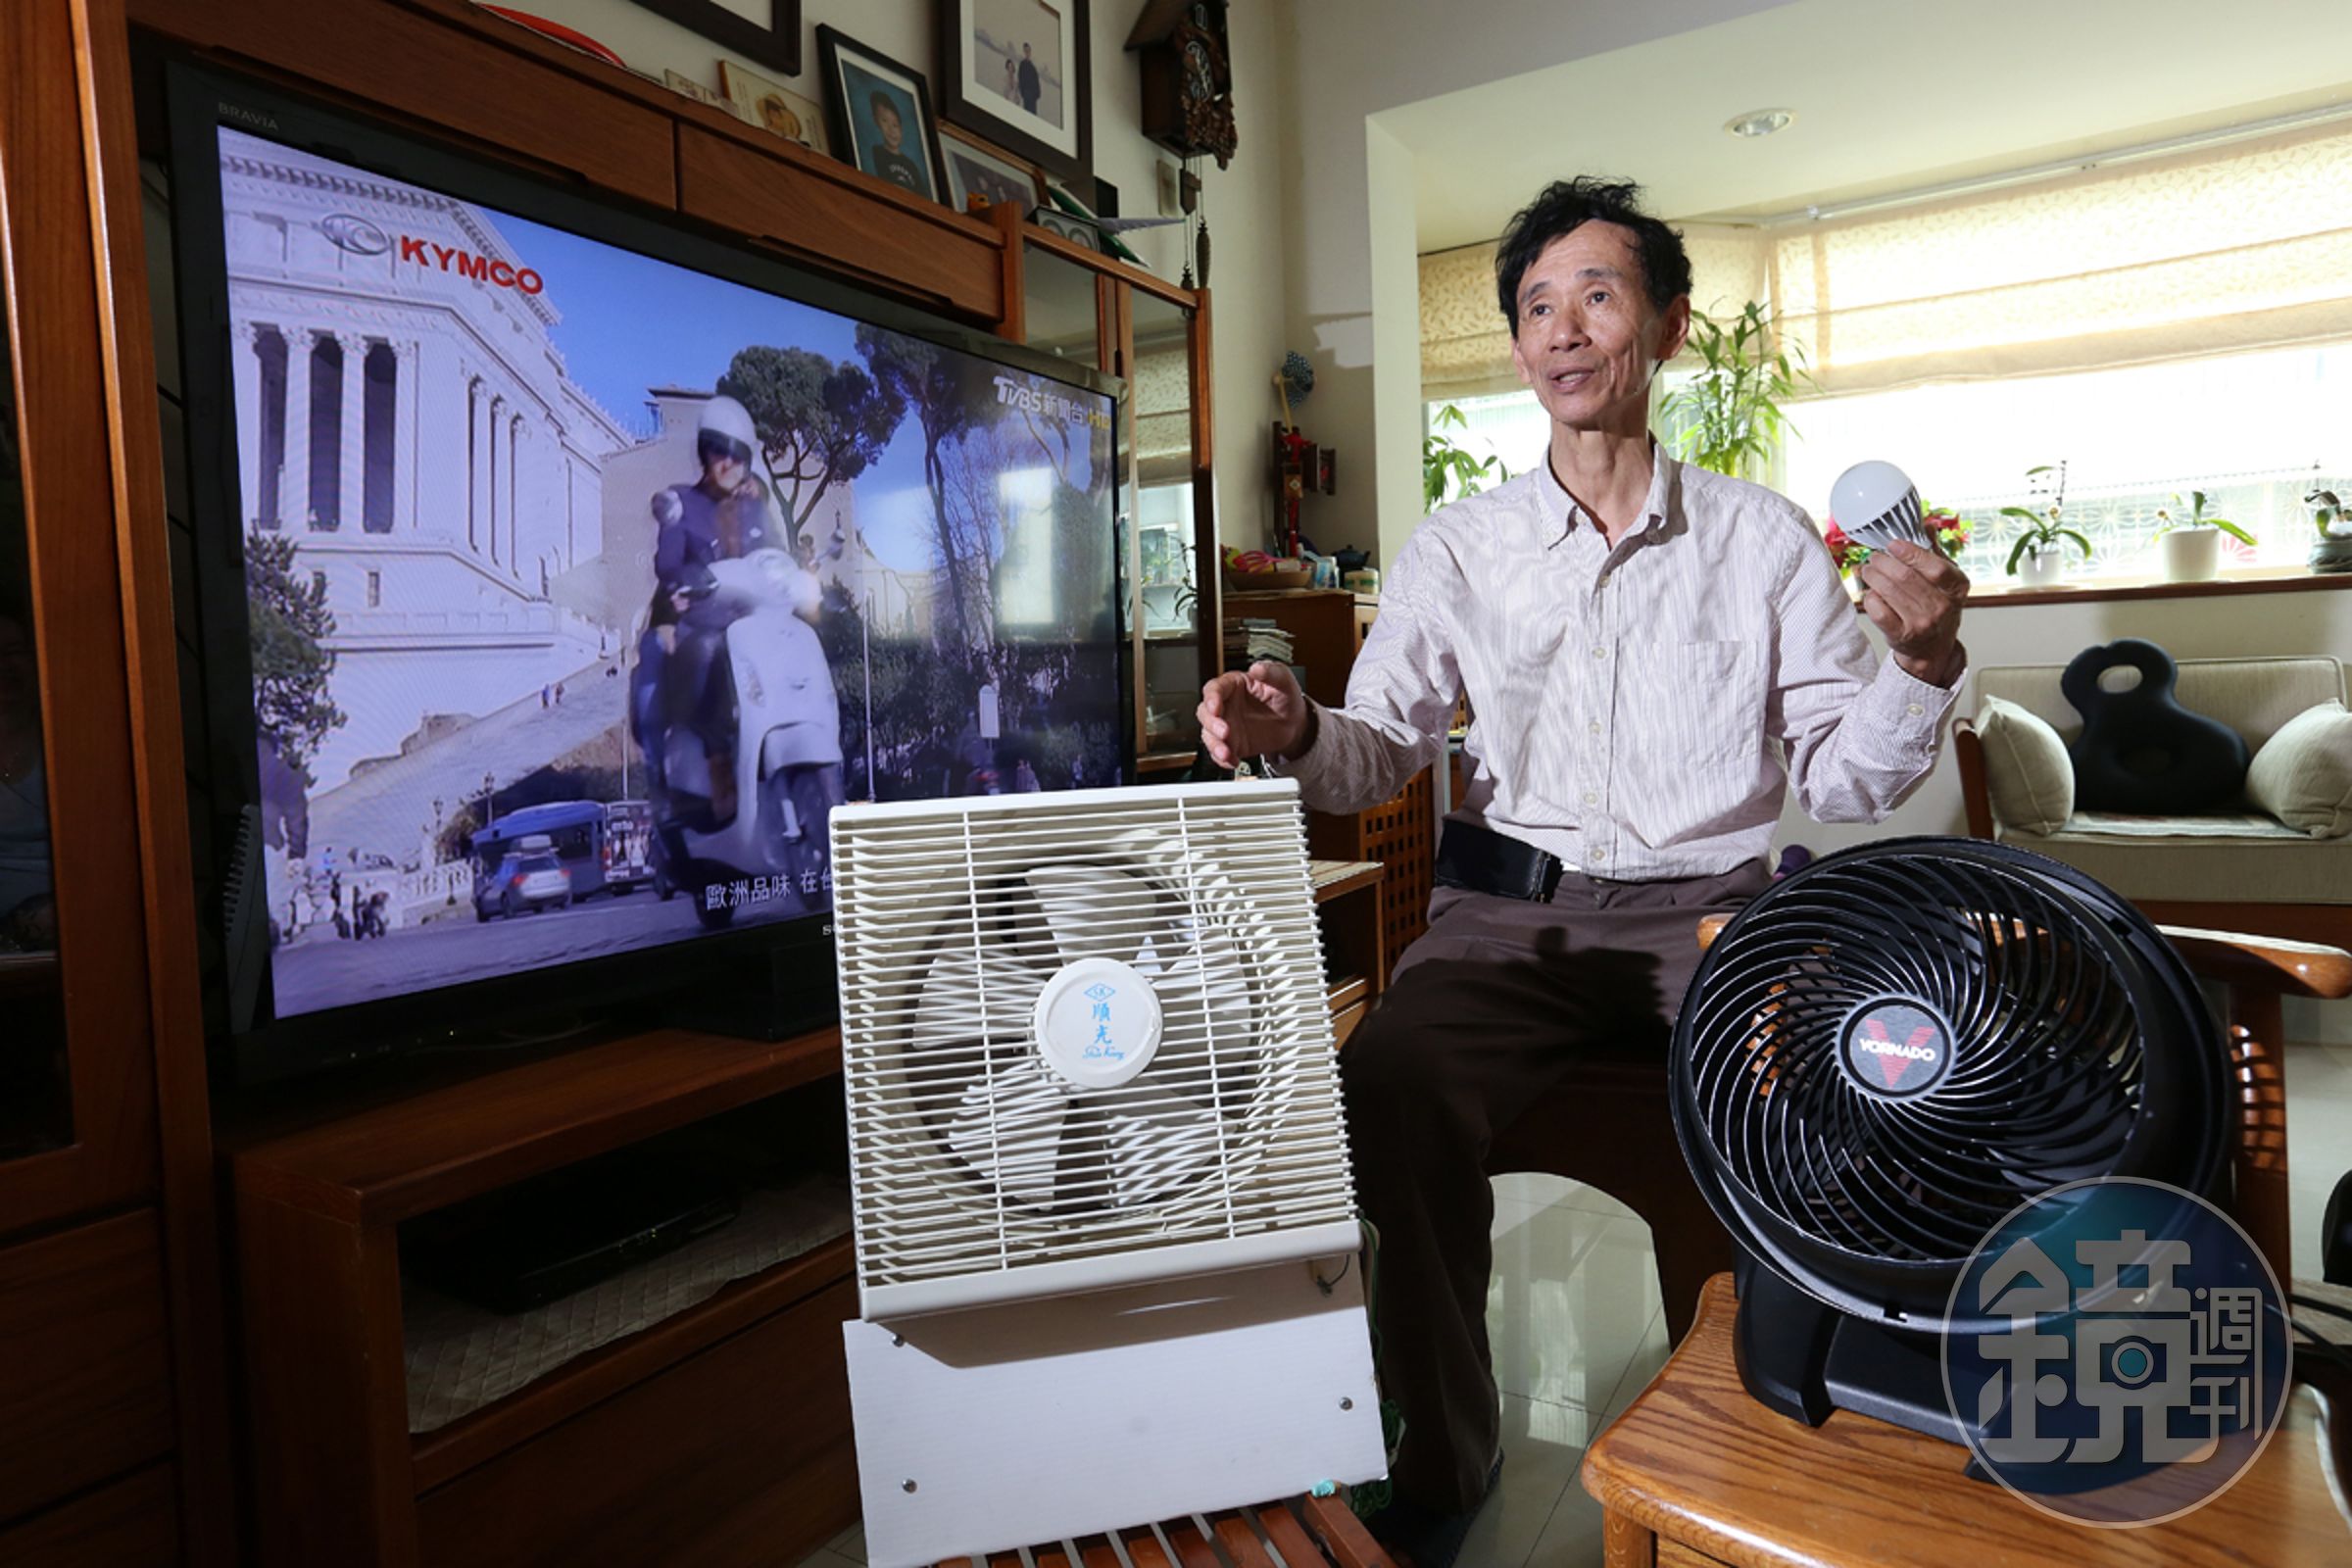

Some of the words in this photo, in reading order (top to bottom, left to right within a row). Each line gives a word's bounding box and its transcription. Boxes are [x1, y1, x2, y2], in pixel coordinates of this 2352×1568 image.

[219, 102, 279, 130] BRAVIA
[400, 235, 544, 295] KYMCO
[705, 874, 791, 910] 歐洲品味
[1859, 1038, 1936, 1062] VORNADO
